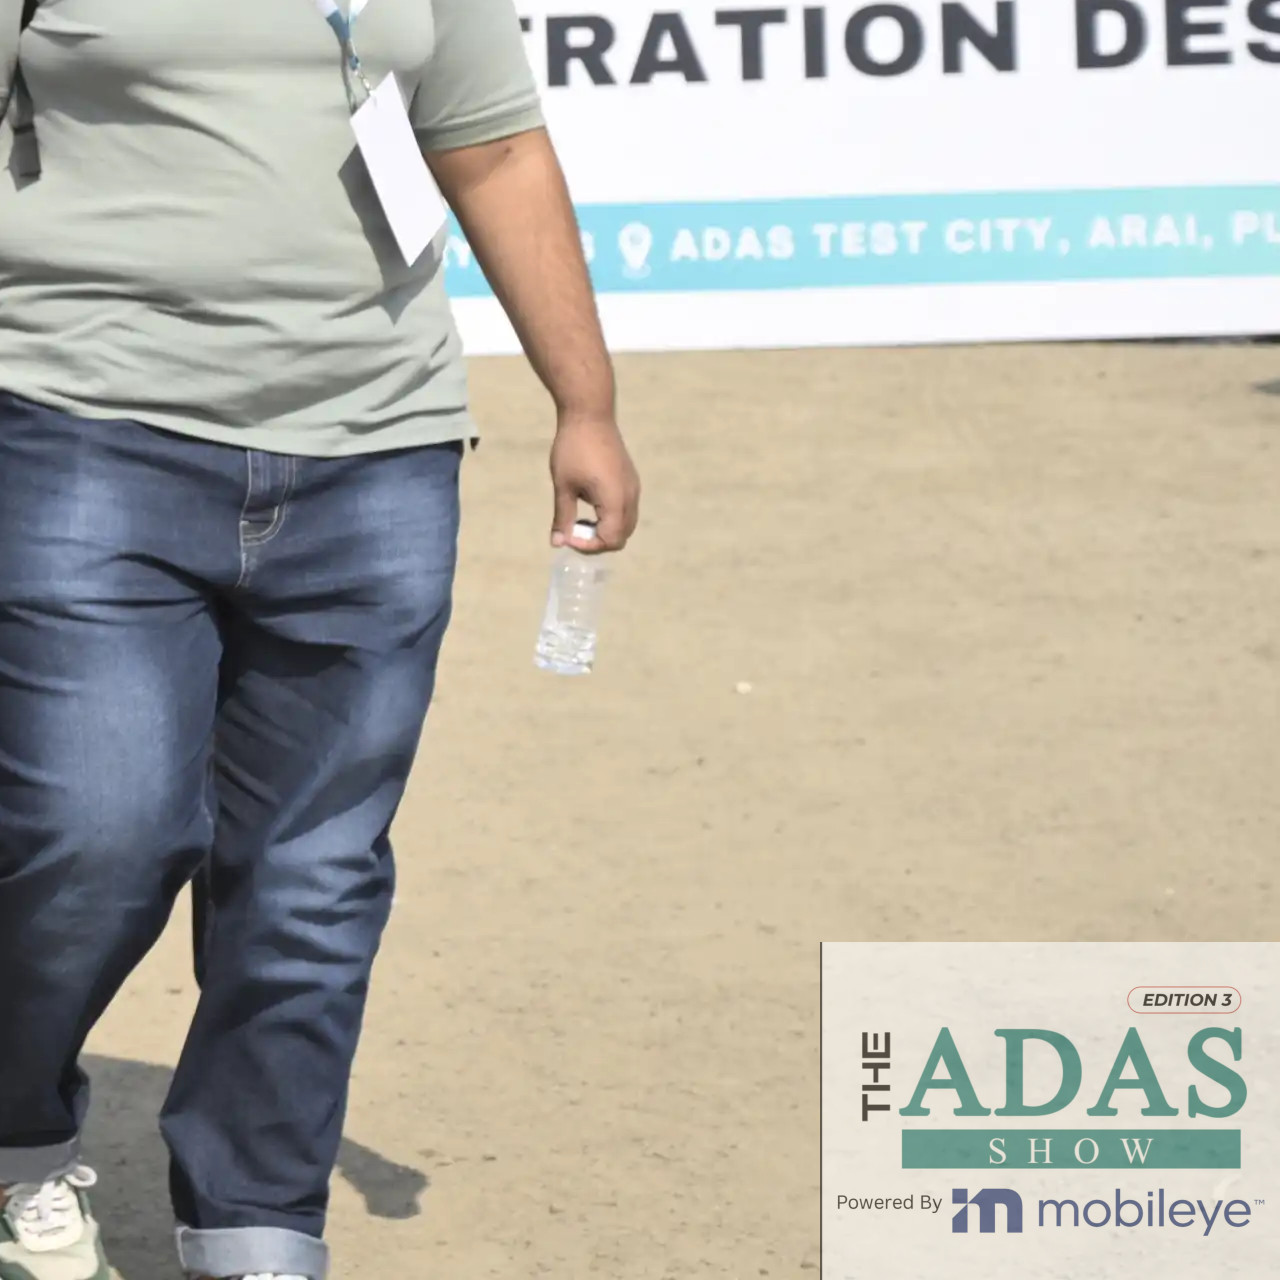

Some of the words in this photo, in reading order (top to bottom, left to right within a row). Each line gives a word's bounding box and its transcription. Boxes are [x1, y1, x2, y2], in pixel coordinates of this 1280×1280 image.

[670, 223, 795, 261] ADAS
[812, 220, 928, 257] TEST
[944, 217, 1071, 256] CITY,
